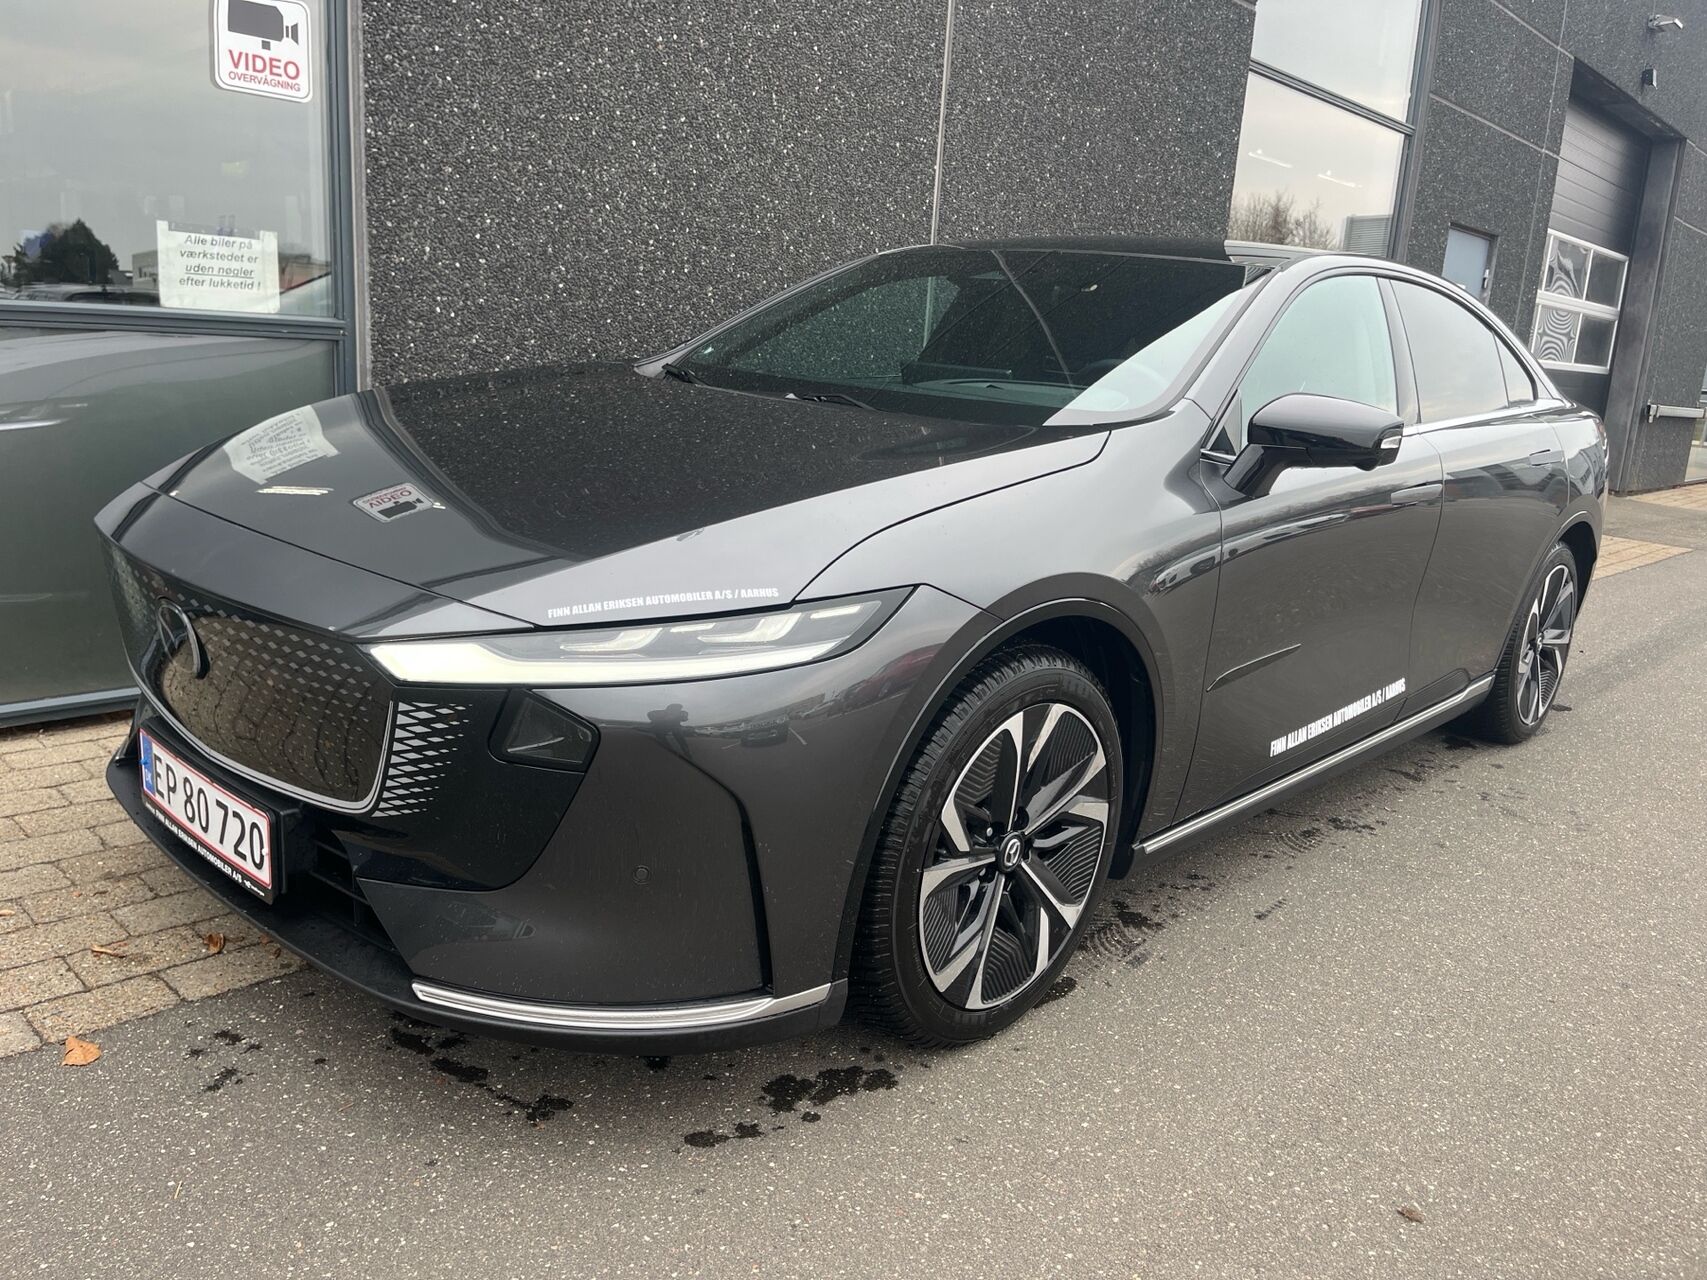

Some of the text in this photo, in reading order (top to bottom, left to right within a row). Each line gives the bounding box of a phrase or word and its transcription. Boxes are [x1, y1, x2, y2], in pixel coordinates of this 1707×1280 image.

[228, 49, 300, 80] VIDEO
[228, 71, 300, 92] OVERVÅGNING
[184, 235, 253, 251] Alle biler på
[180, 250, 259, 264] værkstedet er
[185, 264, 254, 278] uden nøgler
[179, 276, 206, 288] efter
[209, 278, 254, 290] lukketid
[547, 607, 571, 618] FINN
[572, 603, 602, 615] ALLAN
[603, 597, 644, 611] ERIKSEN
[645, 590, 714, 606] AUTOMOBILER
[714, 589, 733, 600] A/S
[740, 587, 779, 598] AARHUS
[1286, 725, 1308, 750] ALLAN
[1307, 713, 1333, 740] ERIKSEN
[153, 753, 265, 870] EP 80 720
